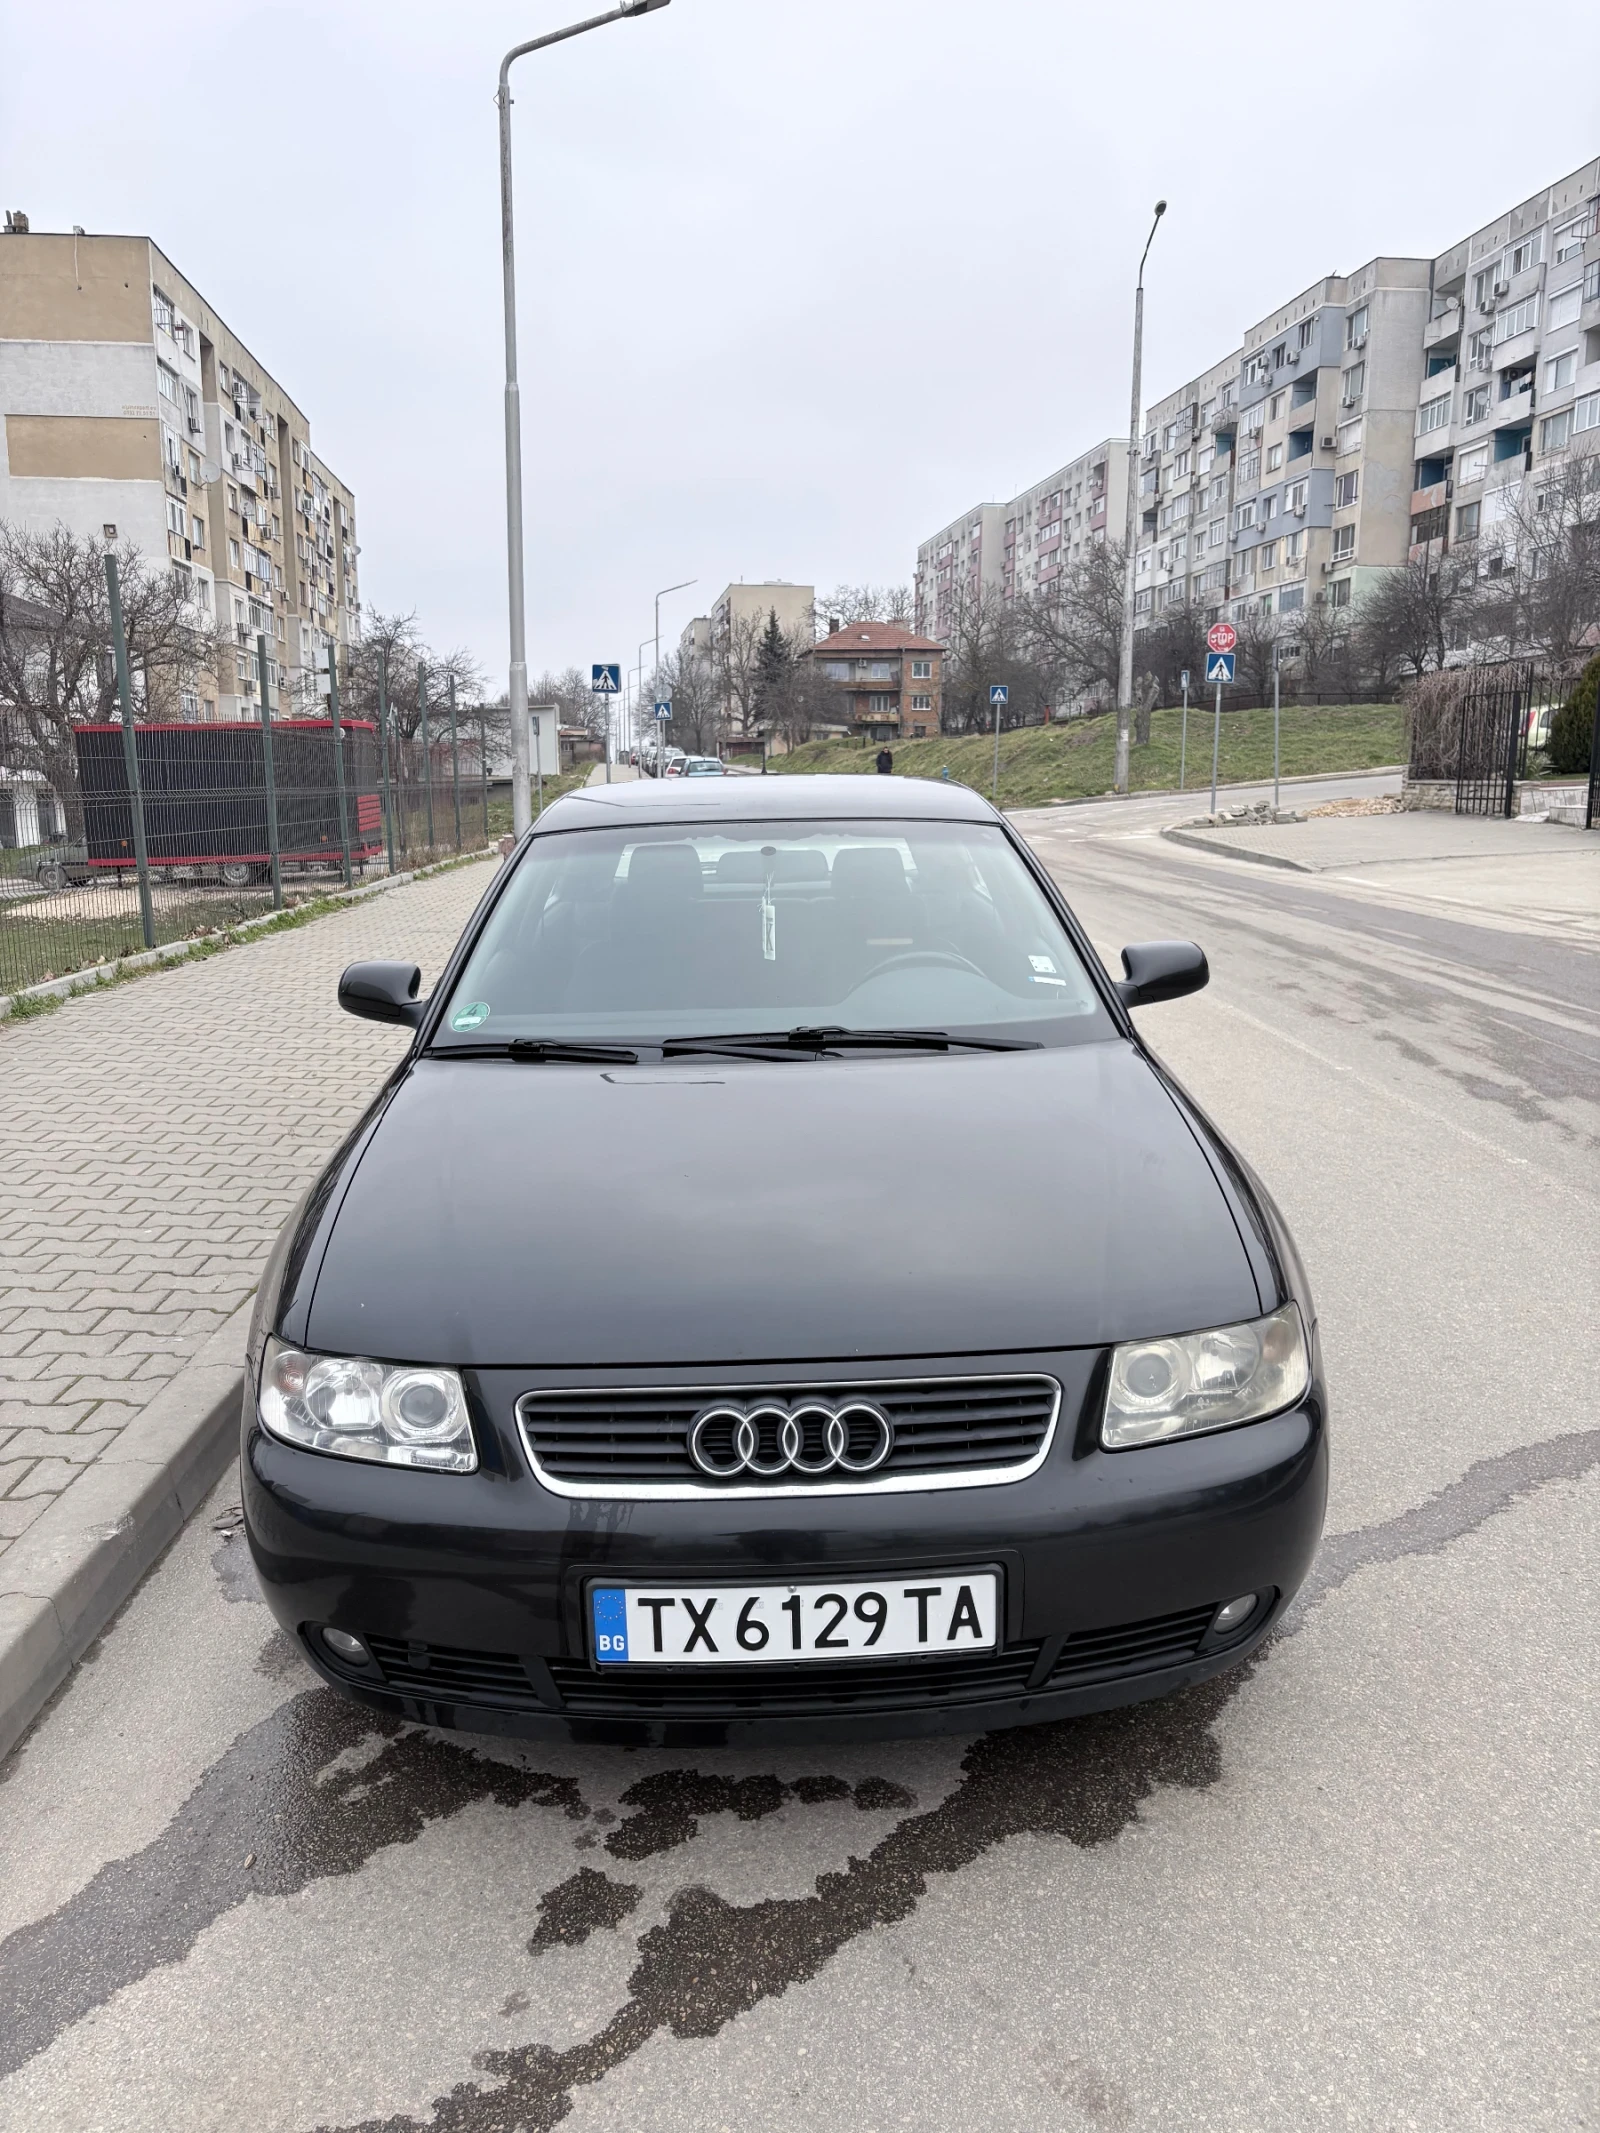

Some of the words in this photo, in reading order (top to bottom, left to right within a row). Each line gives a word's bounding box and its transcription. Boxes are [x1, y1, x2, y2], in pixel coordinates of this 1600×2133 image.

[1210, 632, 1234, 644] STOP
[466, 1004, 478, 1016] 4
[638, 1597, 719, 1652] TX
[736, 1591, 888, 1651] 6129
[903, 1585, 983, 1642] TA
[600, 1635, 625, 1651] BG
